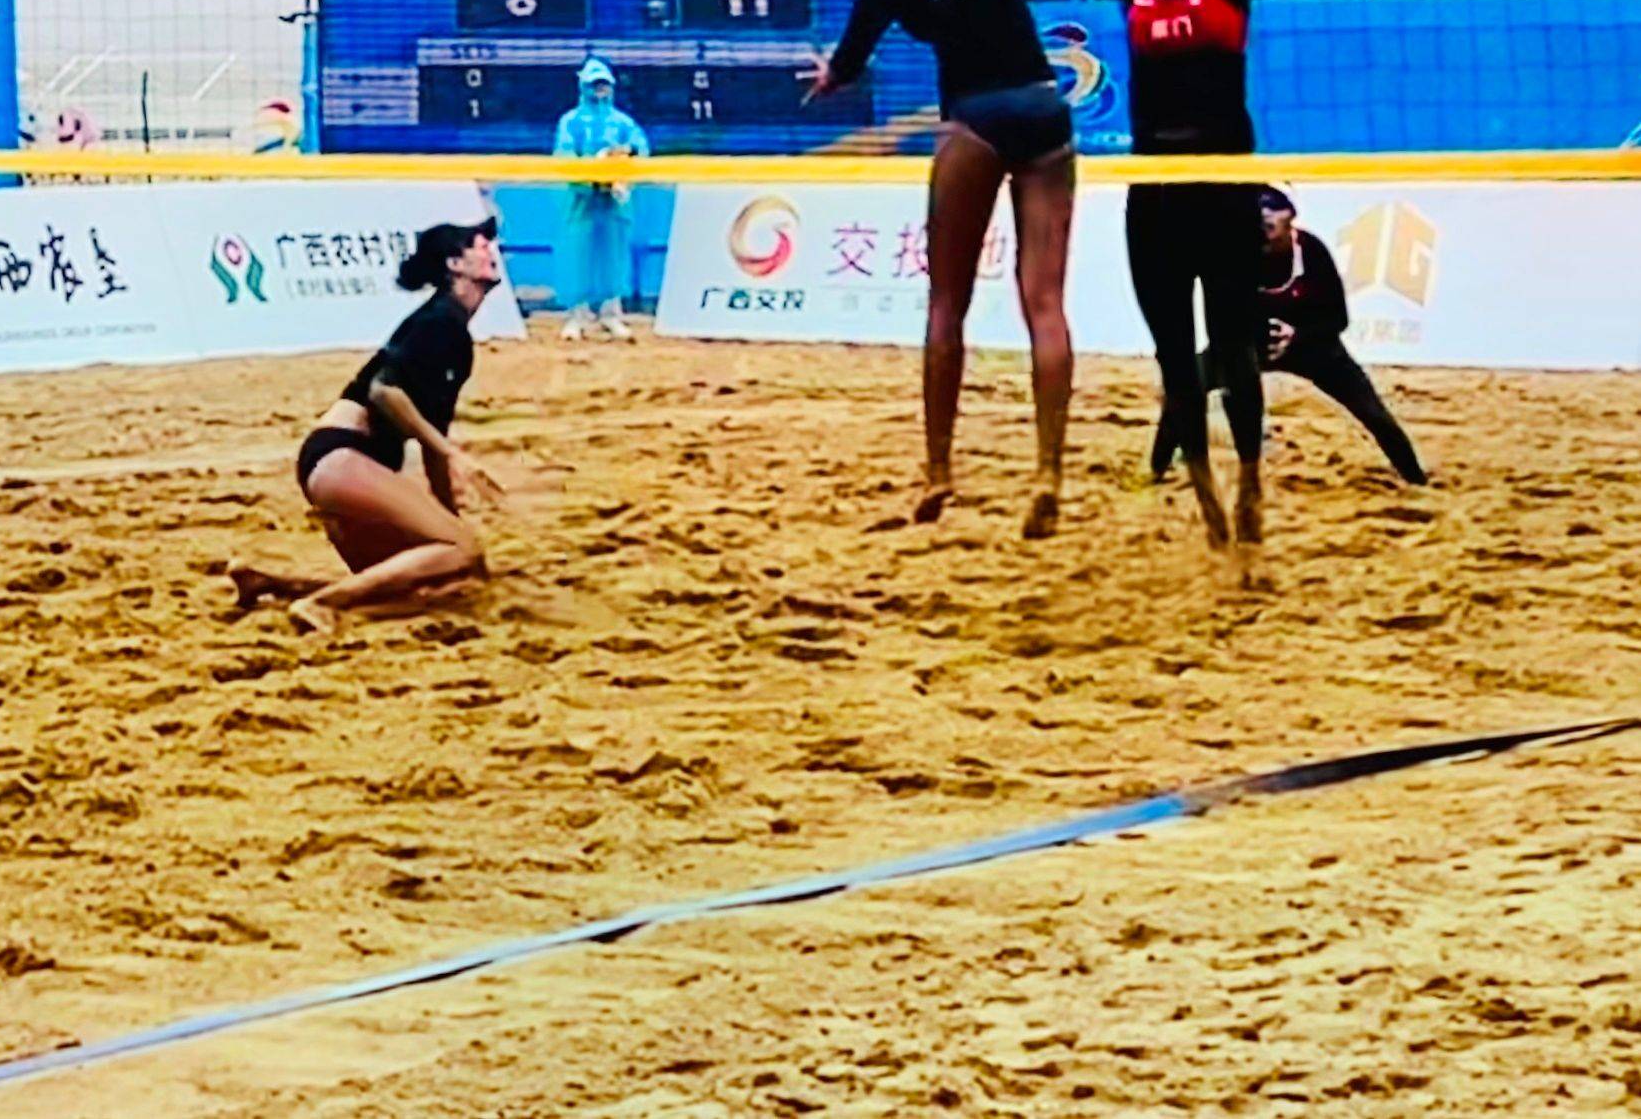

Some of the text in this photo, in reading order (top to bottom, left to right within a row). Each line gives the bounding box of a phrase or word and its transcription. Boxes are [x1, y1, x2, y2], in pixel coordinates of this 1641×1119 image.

[468, 99, 481, 118] 1
[691, 99, 714, 120] 11
[699, 286, 806, 310] 广西交投
